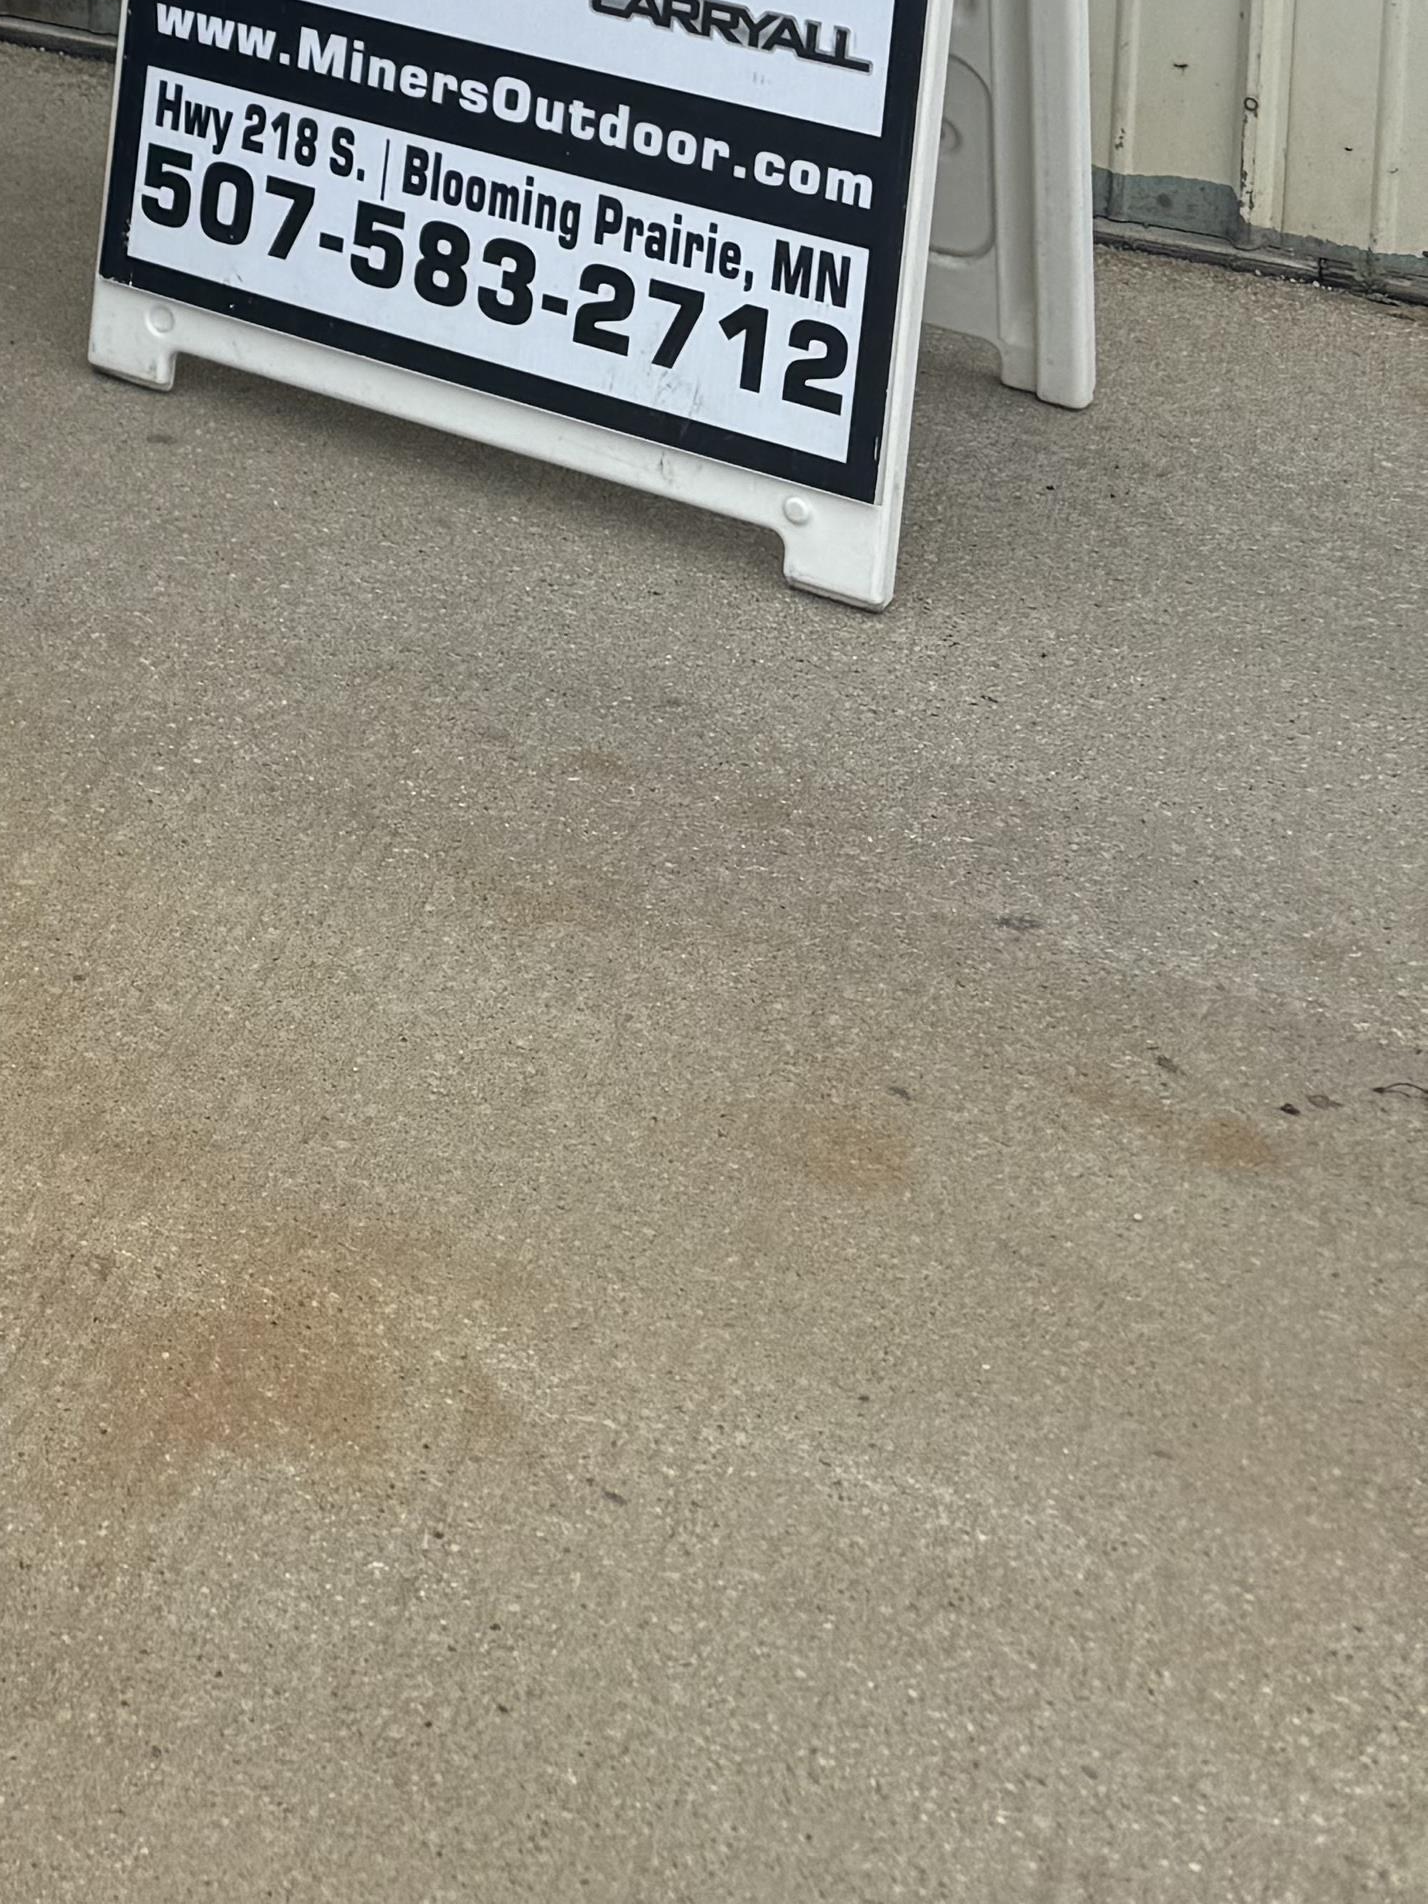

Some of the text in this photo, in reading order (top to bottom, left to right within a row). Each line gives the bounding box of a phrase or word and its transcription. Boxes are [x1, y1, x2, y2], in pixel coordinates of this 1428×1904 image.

[155, 3, 873, 210] www.MinersOutdoor.com
[155, 80, 233, 155] Hwy
[241, 103, 318, 167] 218
[329, 126, 365, 181] S.
[401, 144, 582, 250] Blooming
[594, 194, 754, 292] Prairie,
[771, 239, 852, 309] MN
[141, 142, 849, 416] 507-583-2712
